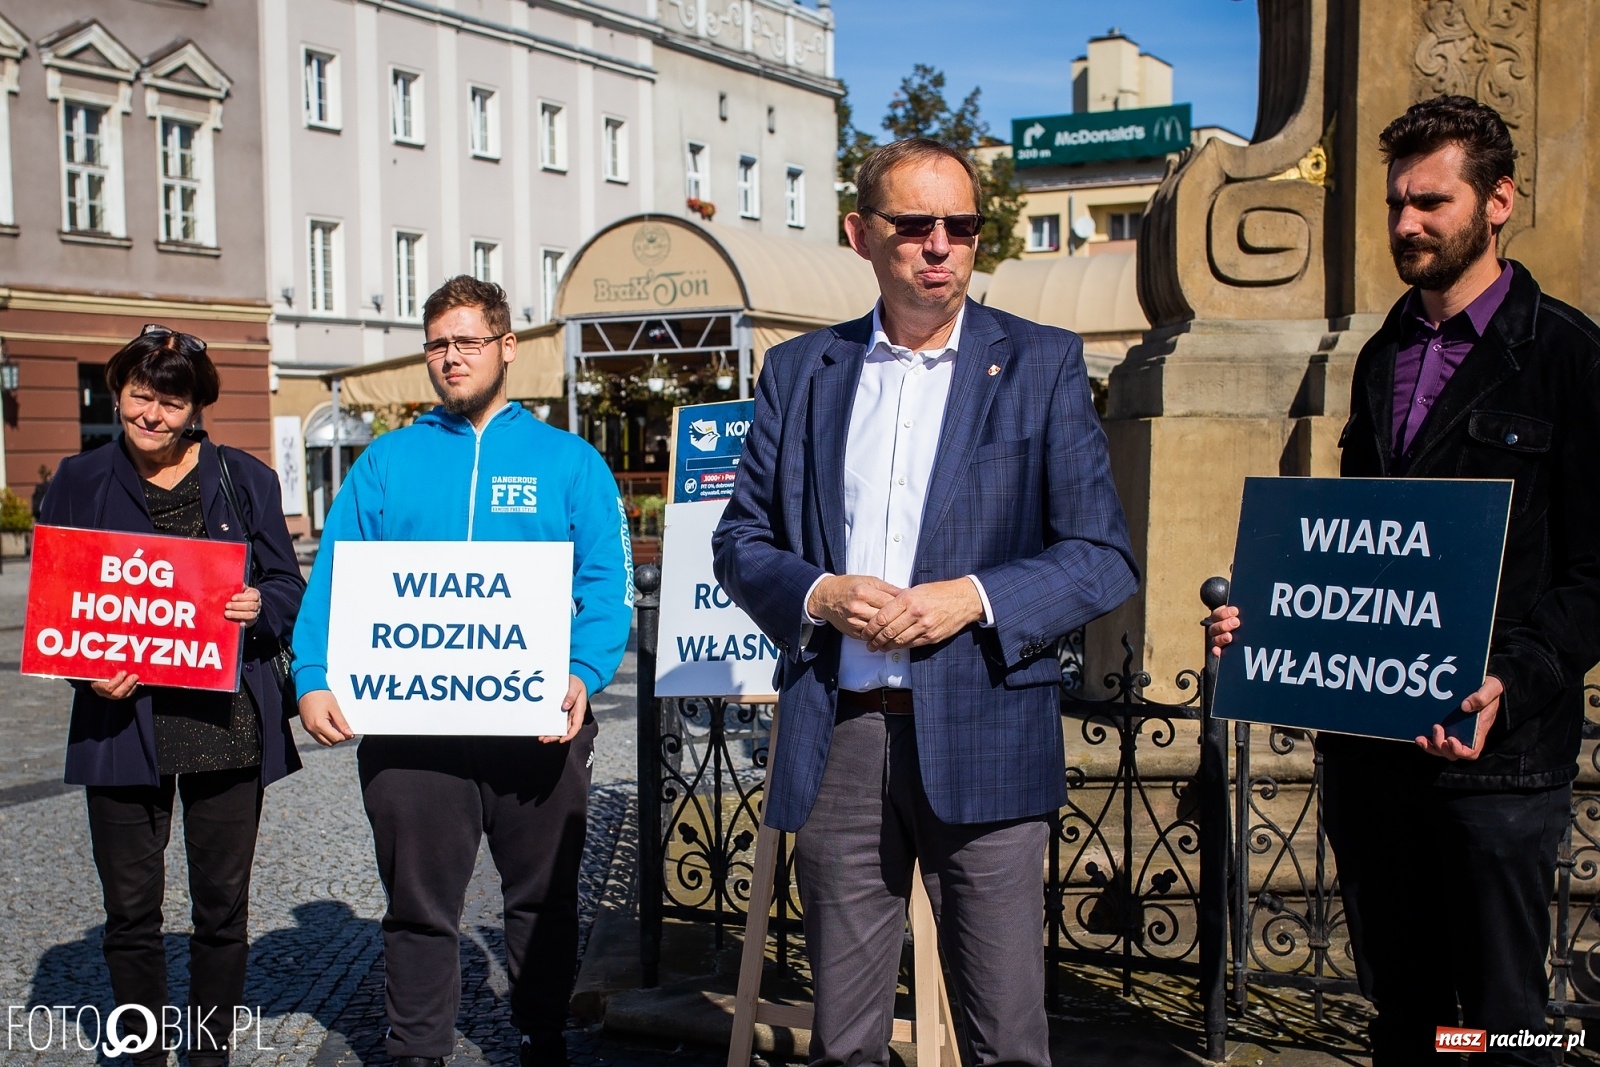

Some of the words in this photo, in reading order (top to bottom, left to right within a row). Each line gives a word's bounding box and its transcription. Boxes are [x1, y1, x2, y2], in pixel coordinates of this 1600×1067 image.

[1054, 124, 1146, 147] McDonald's
[491, 476, 538, 485] DANGEROUS
[491, 484, 537, 506] FFS
[1300, 517, 1431, 557] WIARA
[100, 548, 174, 588] BÓG
[392, 572, 512, 598] WIARA
[71, 591, 196, 629] HONOR
[1270, 582, 1442, 628] RODZINA
[36, 627, 223, 670] OJCZYZNA
[371, 623, 528, 650] RODZINA
[350, 670, 545, 702] WŁASNOŚĆ
[1244, 645, 1458, 700] WŁASNOŚĆ
